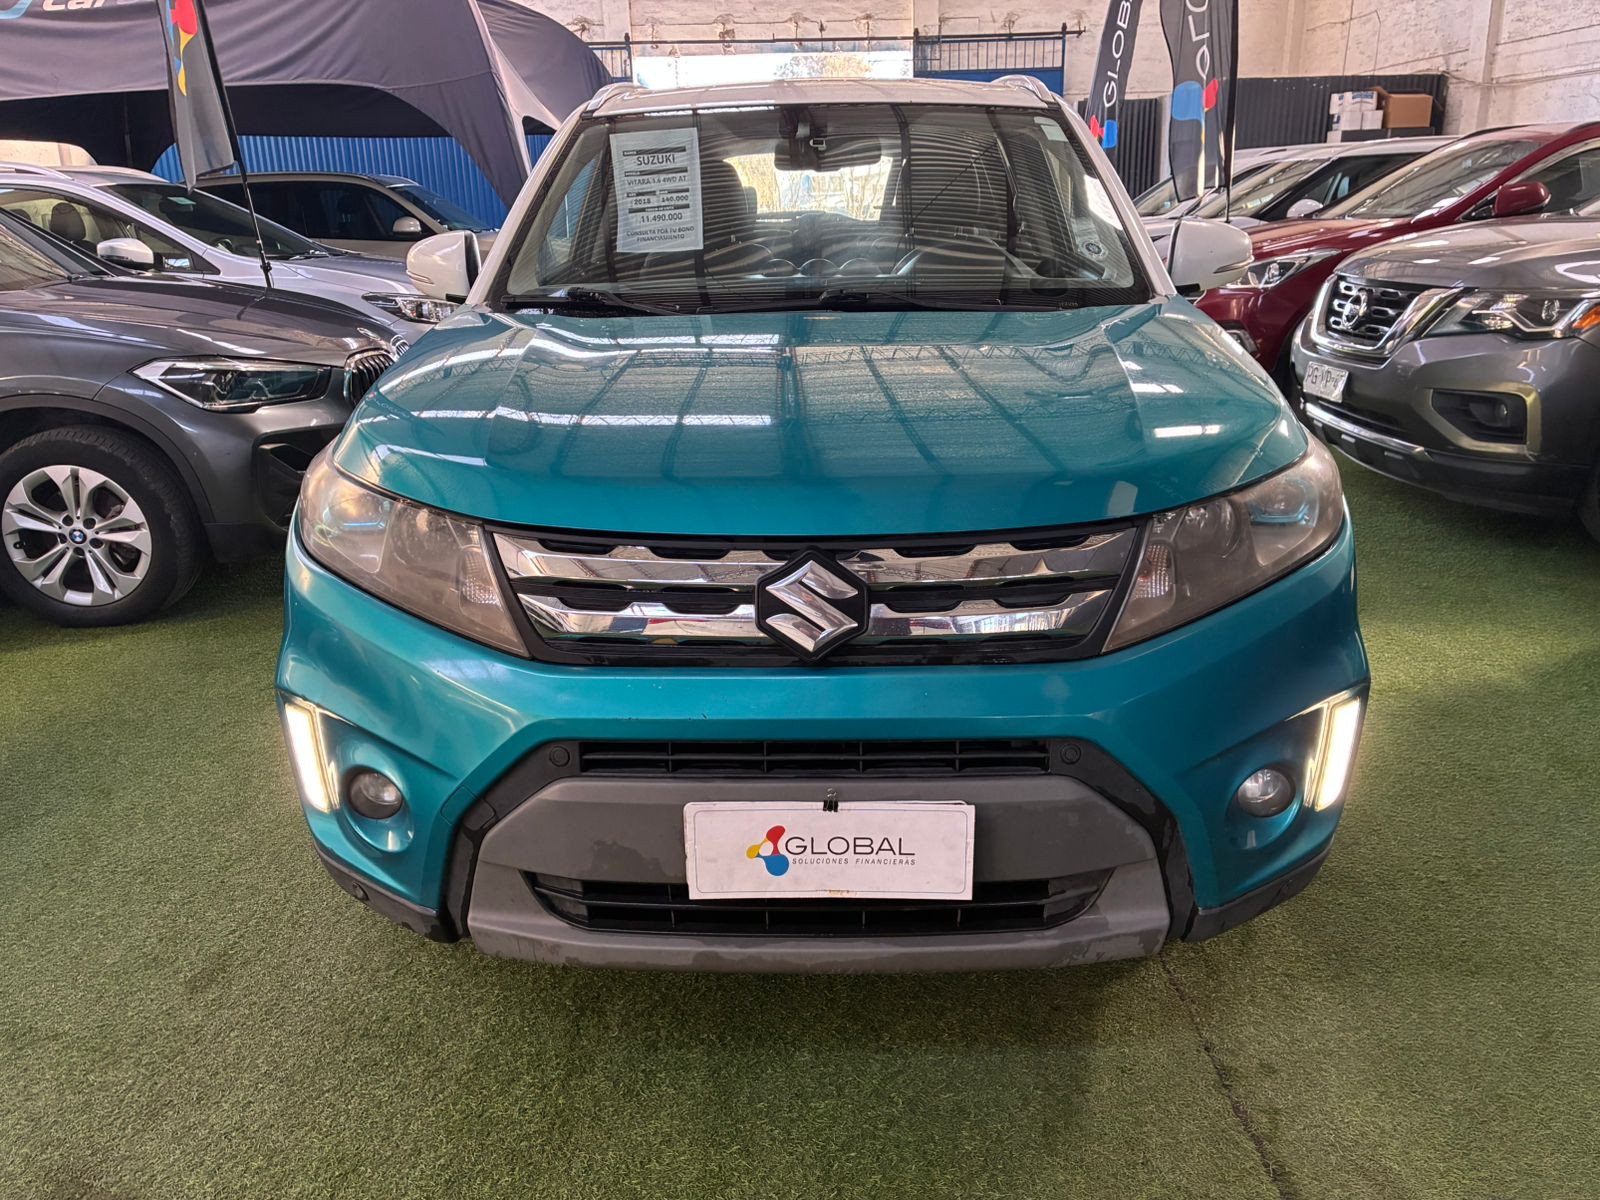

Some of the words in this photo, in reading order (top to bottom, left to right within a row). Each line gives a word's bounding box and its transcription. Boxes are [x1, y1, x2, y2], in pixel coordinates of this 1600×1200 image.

[1103, 0, 1133, 108] GLOB
[637, 154, 675, 165] SUZUKI
[678, 174, 687, 182] AT
[641, 213, 683, 222] 11.490.000
[785, 836, 915, 856] GLOBAL
[792, 857, 849, 865] SOLUCIONES
[855, 857, 917, 866] FINANCIERAS
